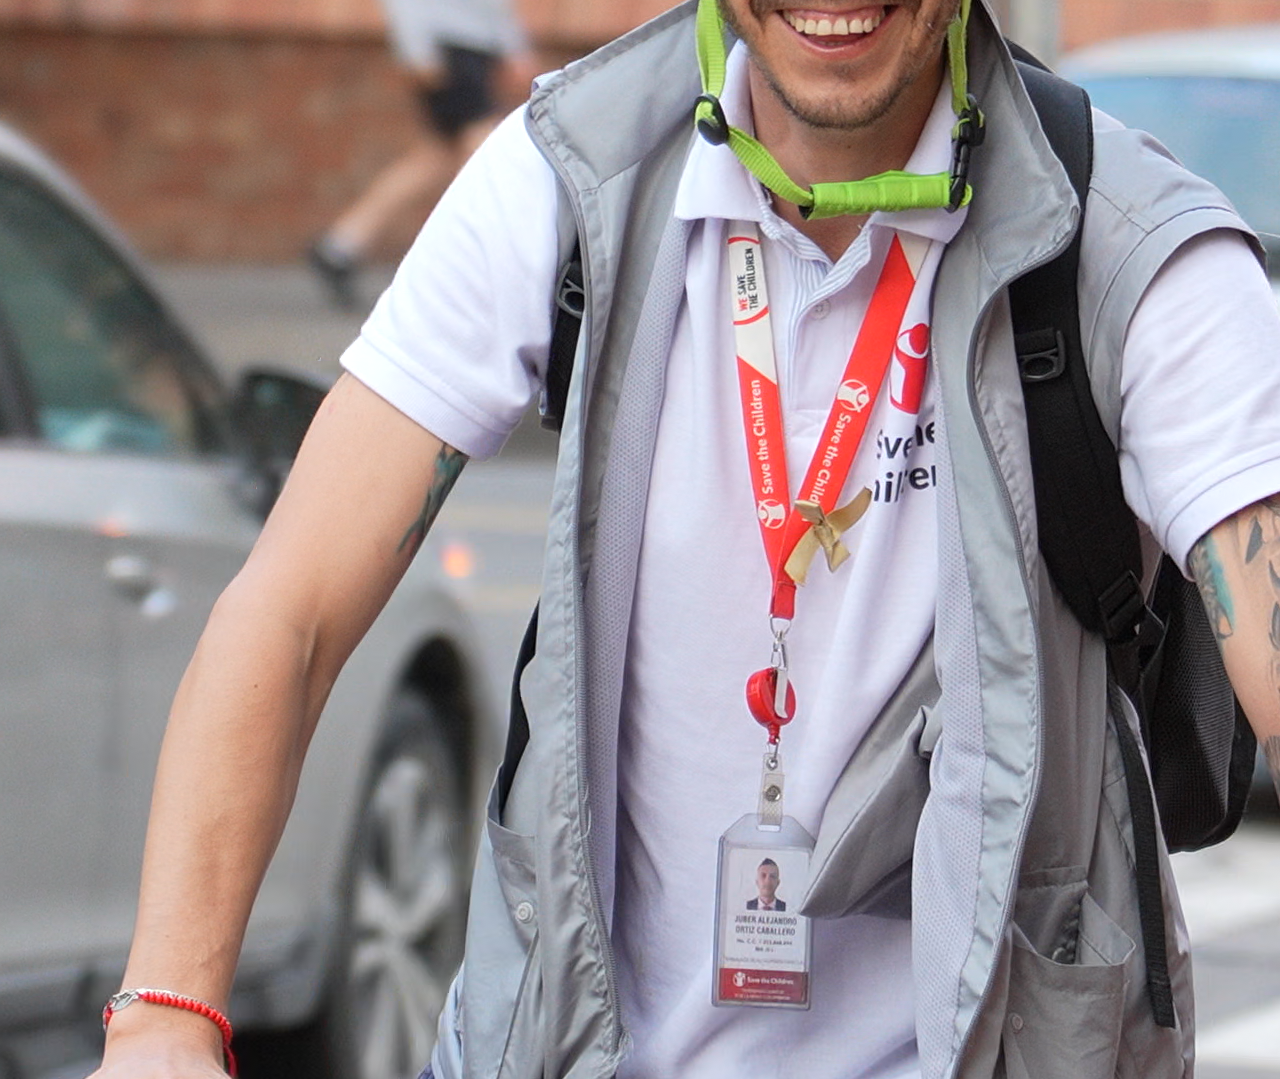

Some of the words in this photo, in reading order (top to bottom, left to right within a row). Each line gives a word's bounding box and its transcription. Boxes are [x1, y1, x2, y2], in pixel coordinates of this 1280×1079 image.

[745, 248, 756, 291] CHILDREN
[737, 275, 747, 295] SAVE
[738, 297, 748, 311] WE
[748, 294, 758, 310] THE
[750, 380, 766, 436] Children
[831, 413, 851, 443] Save
[756, 439, 769, 461] the
[824, 446, 838, 467] the
[761, 464, 774, 494] Save
